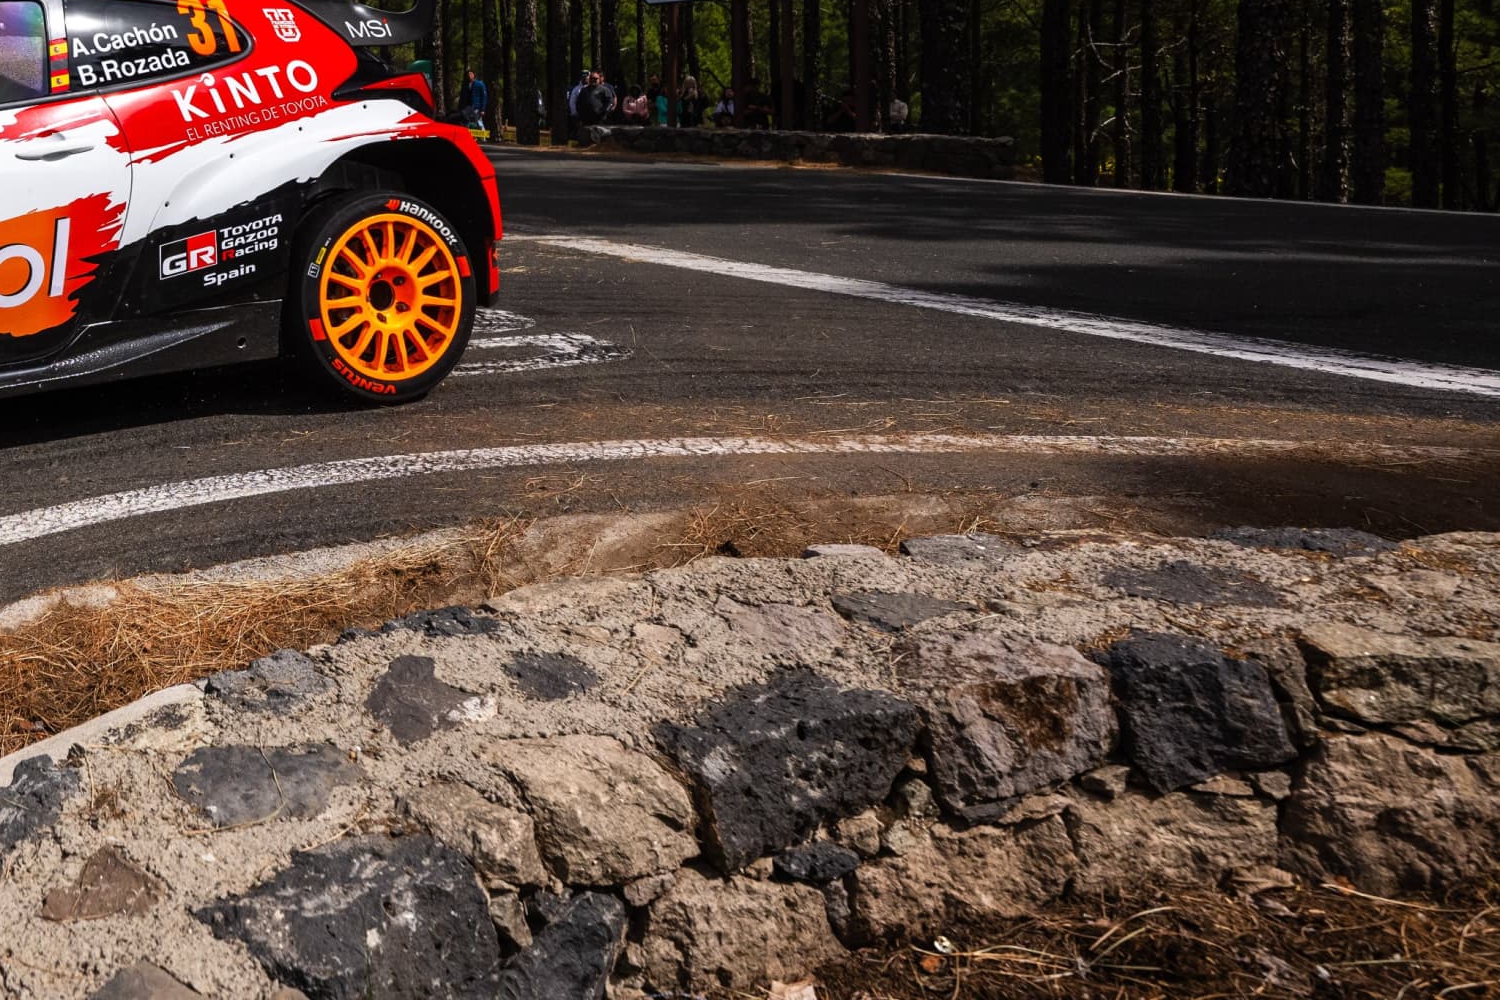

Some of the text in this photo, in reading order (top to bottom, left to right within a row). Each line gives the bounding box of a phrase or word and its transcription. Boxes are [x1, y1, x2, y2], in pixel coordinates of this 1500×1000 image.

[71, 23, 178, 58] A.Cachón
[77, 48, 190, 87] B.Rozada
[186, 95, 328, 141] EL RENTING DE TOYOTA
[220, 214, 283, 238] TOYOTA
[221, 226, 278, 250] GAZOO
[162, 245, 215, 276] GR
[221, 238, 278, 261] Racing
[203, 264, 256, 286] Spain
